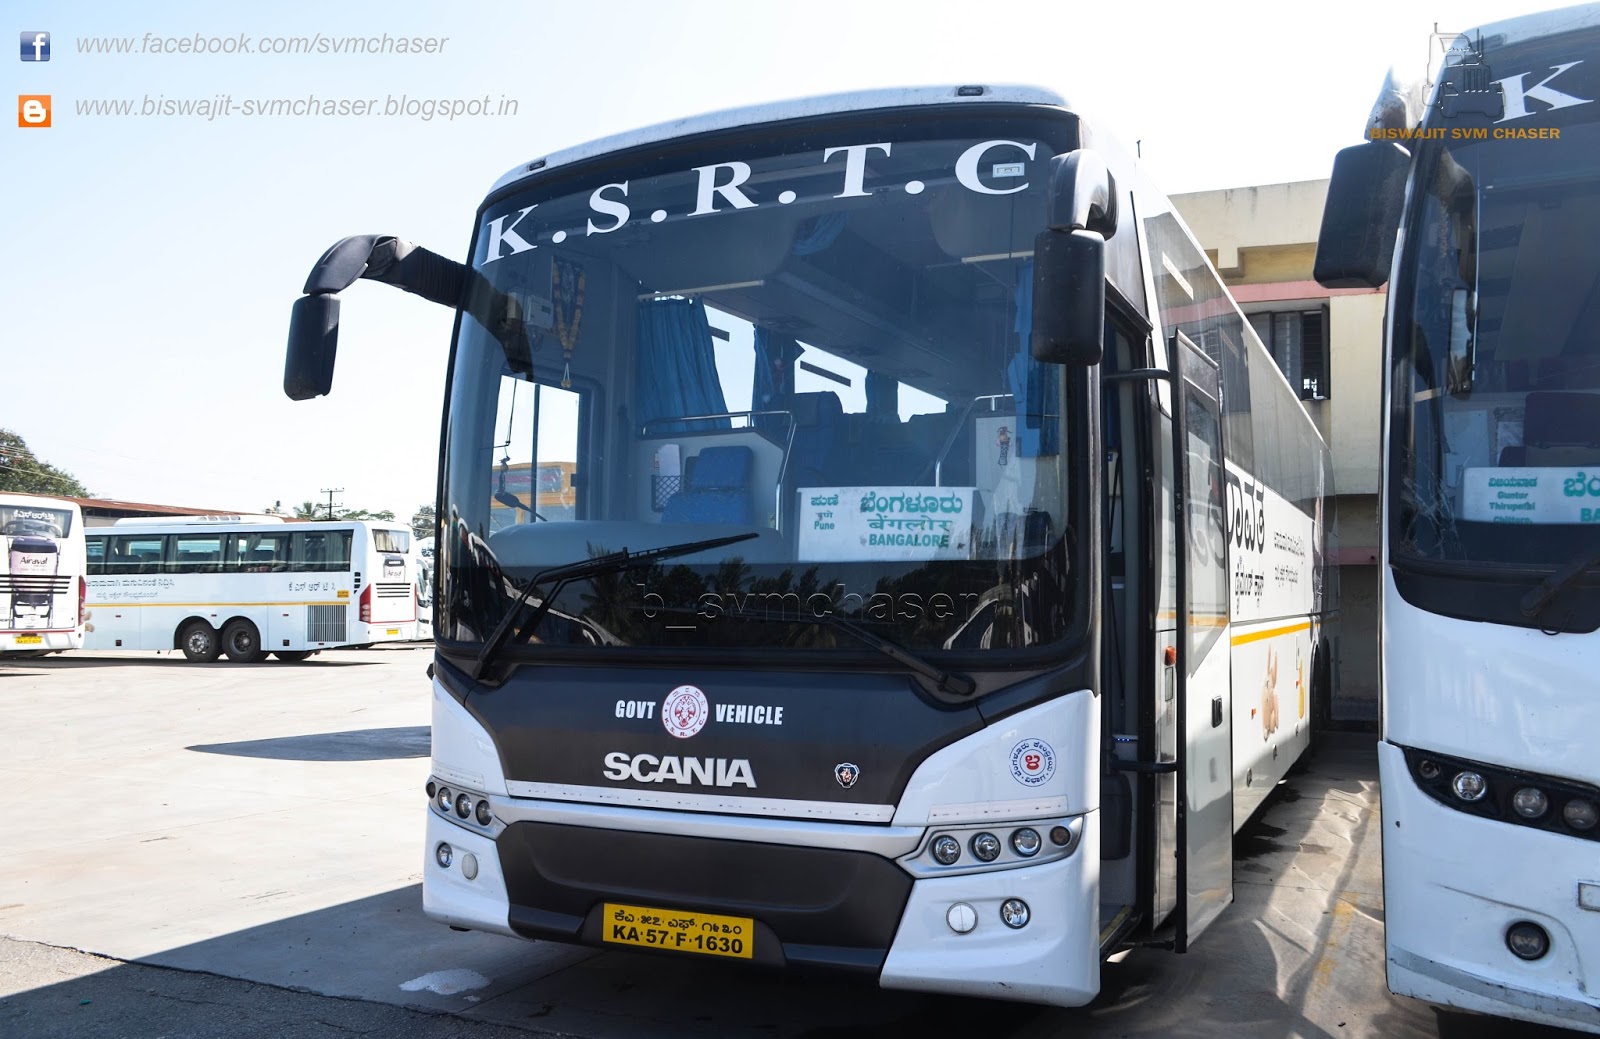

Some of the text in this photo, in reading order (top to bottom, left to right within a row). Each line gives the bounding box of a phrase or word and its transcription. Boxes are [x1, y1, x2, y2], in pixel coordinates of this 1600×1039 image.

[810, 494, 839, 507] ಪುಣೆ
[1497, 491, 1528, 499] Guntur
[860, 491, 963, 514] ಬೆಂಗಳೂರು
[1489, 502, 1535, 511] Thirupathi
[814, 521, 835, 531] Pune
[869, 534, 950, 548] BANGALORE
[615, 699, 784, 726] GOVT VEHICLE
[602, 752, 757, 789] SCANIA
